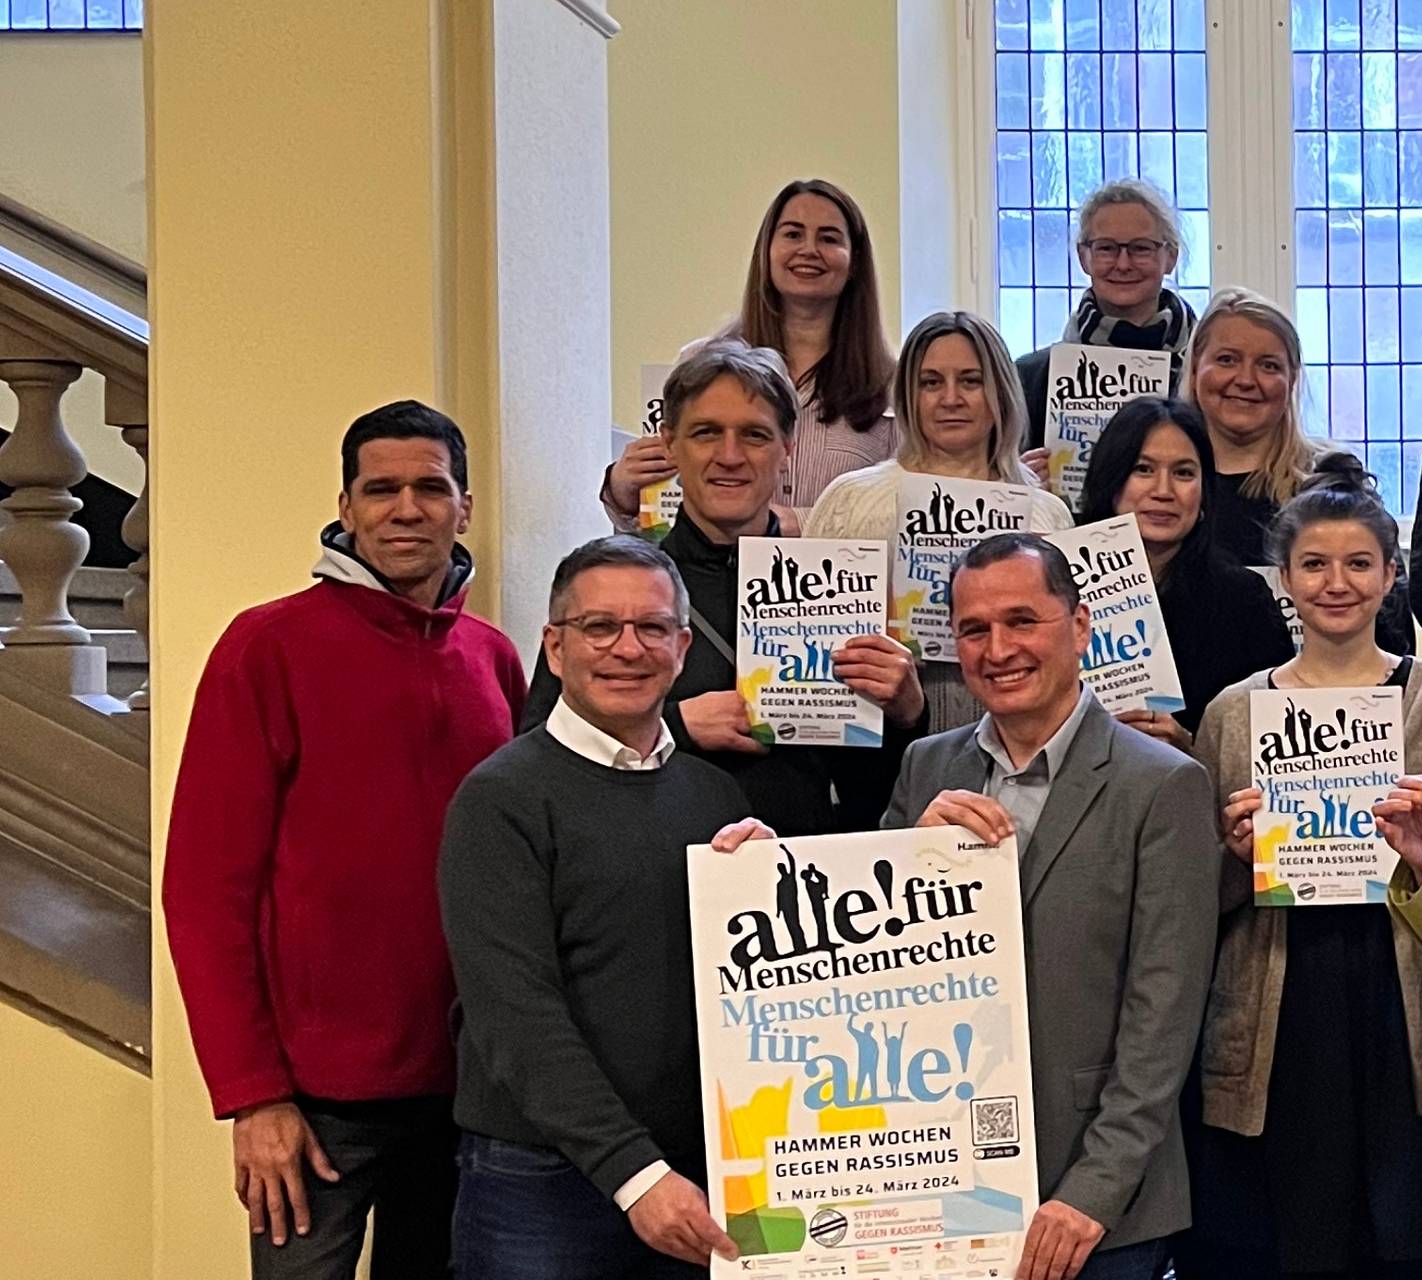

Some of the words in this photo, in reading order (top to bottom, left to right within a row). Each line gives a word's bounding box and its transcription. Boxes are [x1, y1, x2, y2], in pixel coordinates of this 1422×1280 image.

[1056, 350, 1128, 400] alle!
[1130, 373, 1162, 393] für
[1050, 397, 1121, 411] Menschen
[1058, 423, 1088, 443] für
[906, 482, 987, 534] alle!
[987, 509, 1024, 530] für
[908, 560, 941, 582] für
[1096, 548, 1135, 576] für
[746, 545, 836, 605] alle!
[836, 570, 877, 594] für
[741, 599, 882, 620] Menschenrechte
[741, 621, 882, 638] Menschenrechte
[752, 634, 788, 658] für
[761, 687, 807, 695] HAMMER
[761, 698, 794, 706] GEGEN
[798, 699, 857, 707] RASSISMUS
[1259, 697, 1350, 762] alle!
[1351, 719, 1393, 744] für
[1255, 748, 1398, 776] Menschenrechte
[1256, 771, 1399, 793] Menschenrechte
[1268, 789, 1305, 814] für
[1317, 855, 1378, 864] RASSISMUS
[1330, 843, 1374, 851] WOCHEN
[727, 843, 904, 965] alle!
[900, 876, 983, 926] für
[717, 928, 996, 994] Menschenrechte
[719, 971, 999, 1028] Menschenrechte
[746, 1021, 820, 1063] für
[803, 1014, 975, 1110] alle!
[774, 1135, 861, 1155] HAMMER
[868, 1126, 951, 1146] WOCHEN
[776, 1160, 839, 1177] GEGEN
[846, 1149, 959, 1172] RASSISMUS
[777, 1192, 786, 1201] 1.
[792, 1190, 827, 1200] März
[832, 1186, 851, 1197] bis
[856, 1184, 878, 1195] 24.
[884, 1181, 918, 1192] März
[923, 1176, 960, 1189] 2024
[854, 1208, 899, 1220] STIFTUNG
[855, 1229, 887, 1239] GEGEN
[890, 1223, 944, 1236] RASSISMUS
